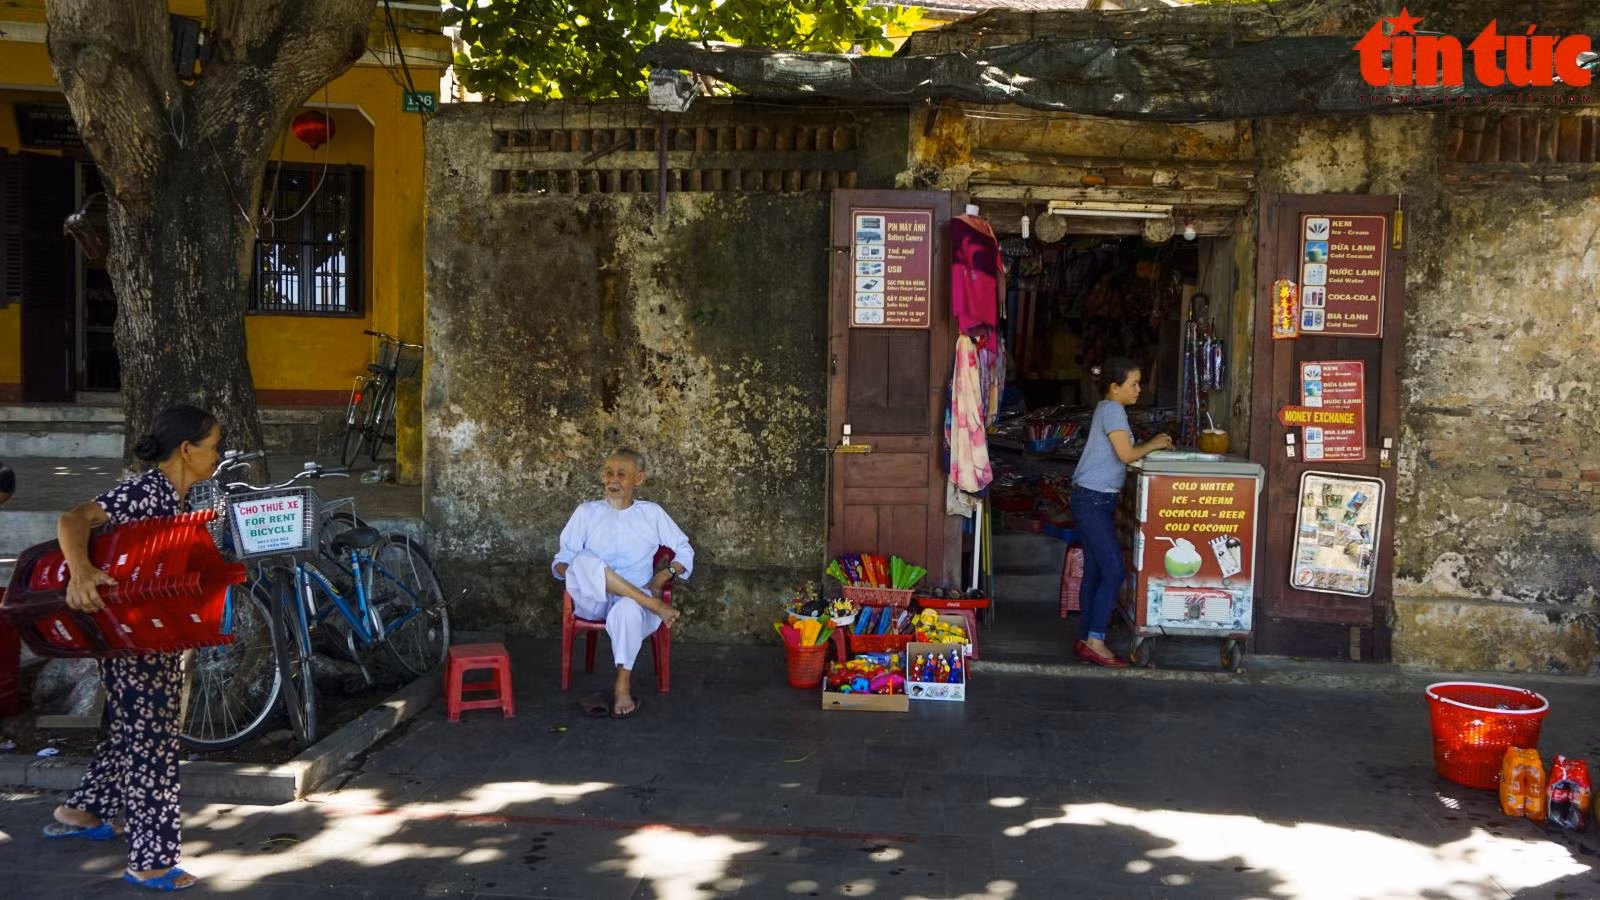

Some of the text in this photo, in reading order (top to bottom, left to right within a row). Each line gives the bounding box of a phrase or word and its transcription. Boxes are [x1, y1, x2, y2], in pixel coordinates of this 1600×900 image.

[887, 219, 926, 232] PIN MÁY ẢNH
[887, 233, 923, 243] Battery Camera
[887, 265, 902, 273] USB
[1327, 293, 1377, 302] COCA-COLA
[1327, 312, 1342, 320] BIA
[1284, 410, 1355, 424] MONEY EXCHANGE
[1172, 482, 1234, 491] COLD WATER
[1172, 496, 1189, 504] ICE
[1198, 496, 1234, 505] CREAM
[240, 505, 259, 516] CHO
[287, 500, 299, 509] XE
[1158, 509, 1209, 518] COCACOLA
[1218, 510, 1246, 519] BEER
[245, 513, 296, 527] FOR RENT
[249, 524, 295, 537] BICYCLE
[1165, 523, 1240, 533] COLD COCONUT
